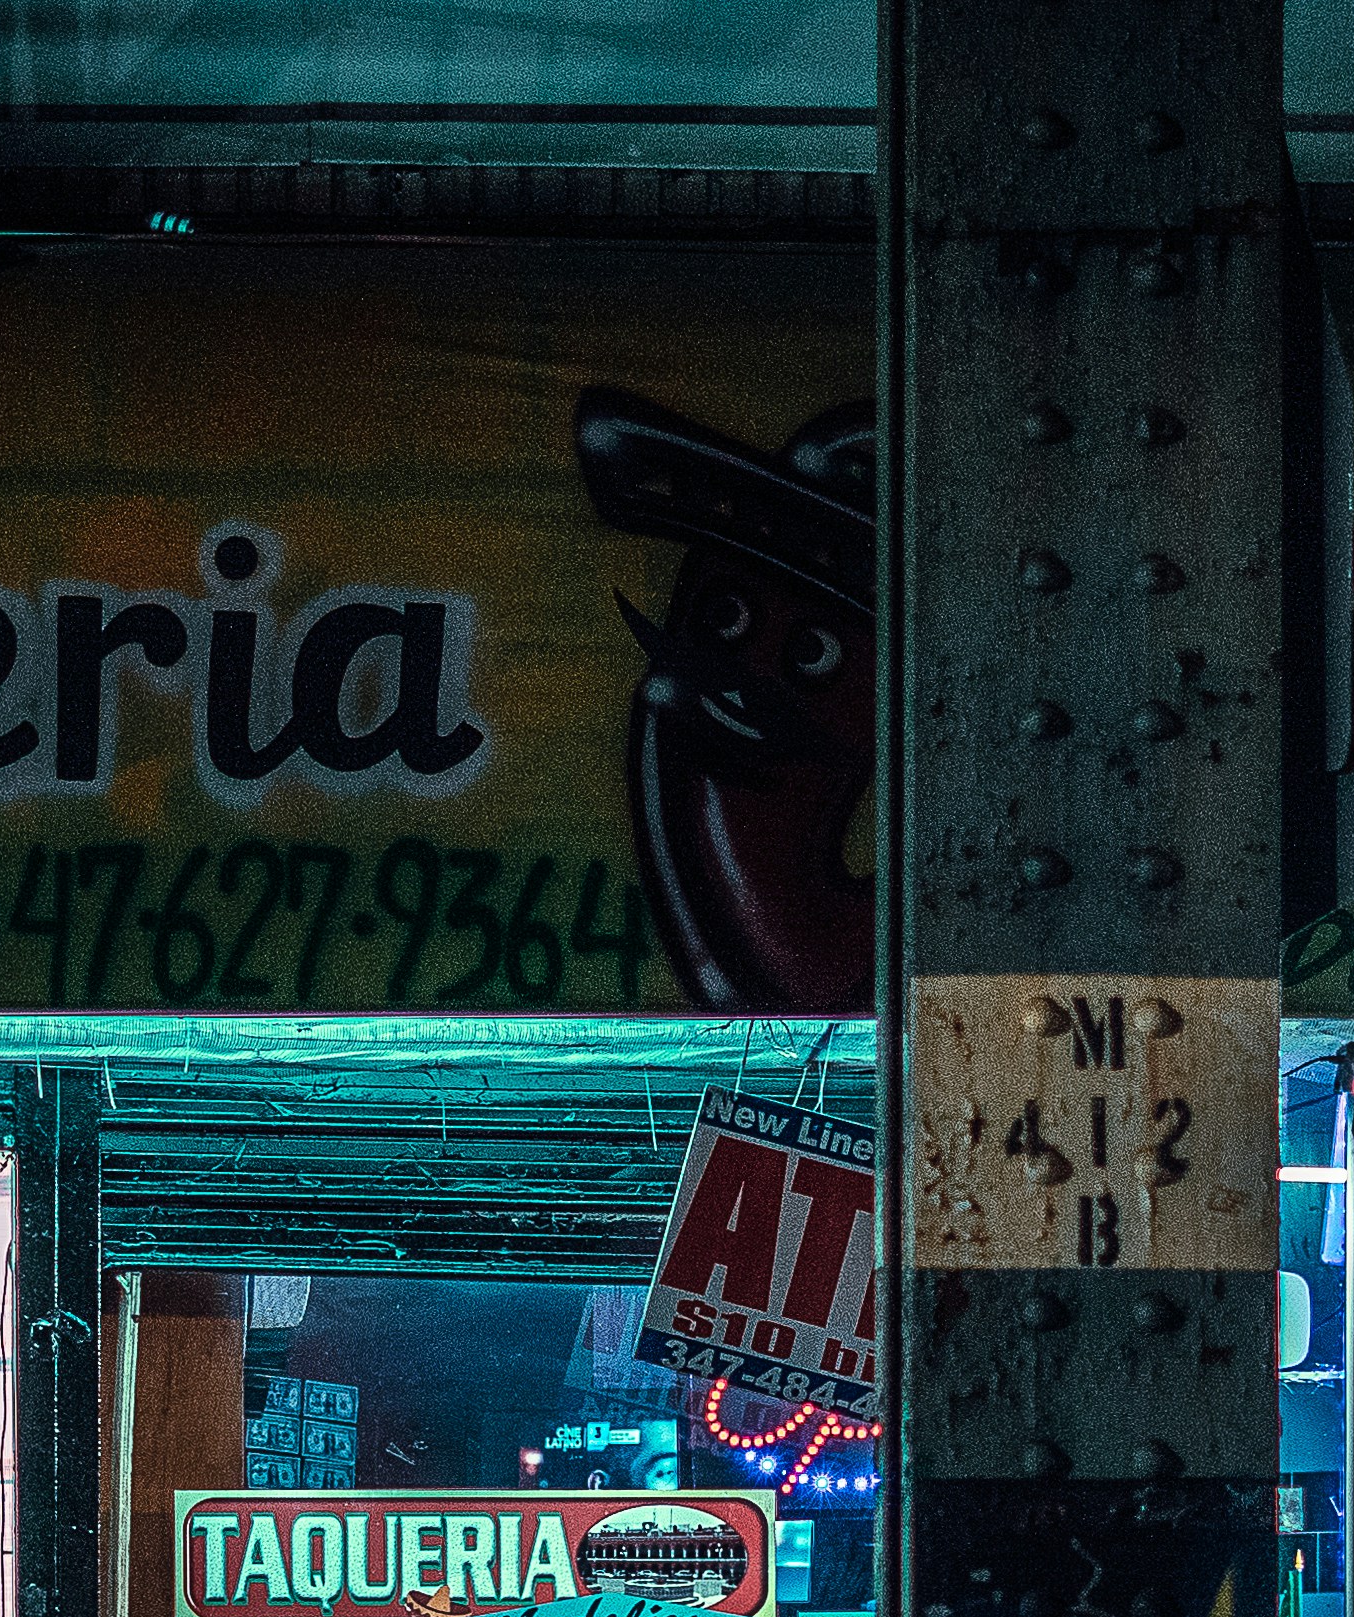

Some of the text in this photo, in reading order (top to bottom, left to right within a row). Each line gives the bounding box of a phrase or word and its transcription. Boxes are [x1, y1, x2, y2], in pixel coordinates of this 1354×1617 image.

[1072, 998, 1125, 1071] M
[706, 1093, 791, 1139] New
[659, 1135, 875, 1342] AT
[1078, 1194, 1120, 1266] B
[190, 1510, 578, 1617] TAQUERIA
